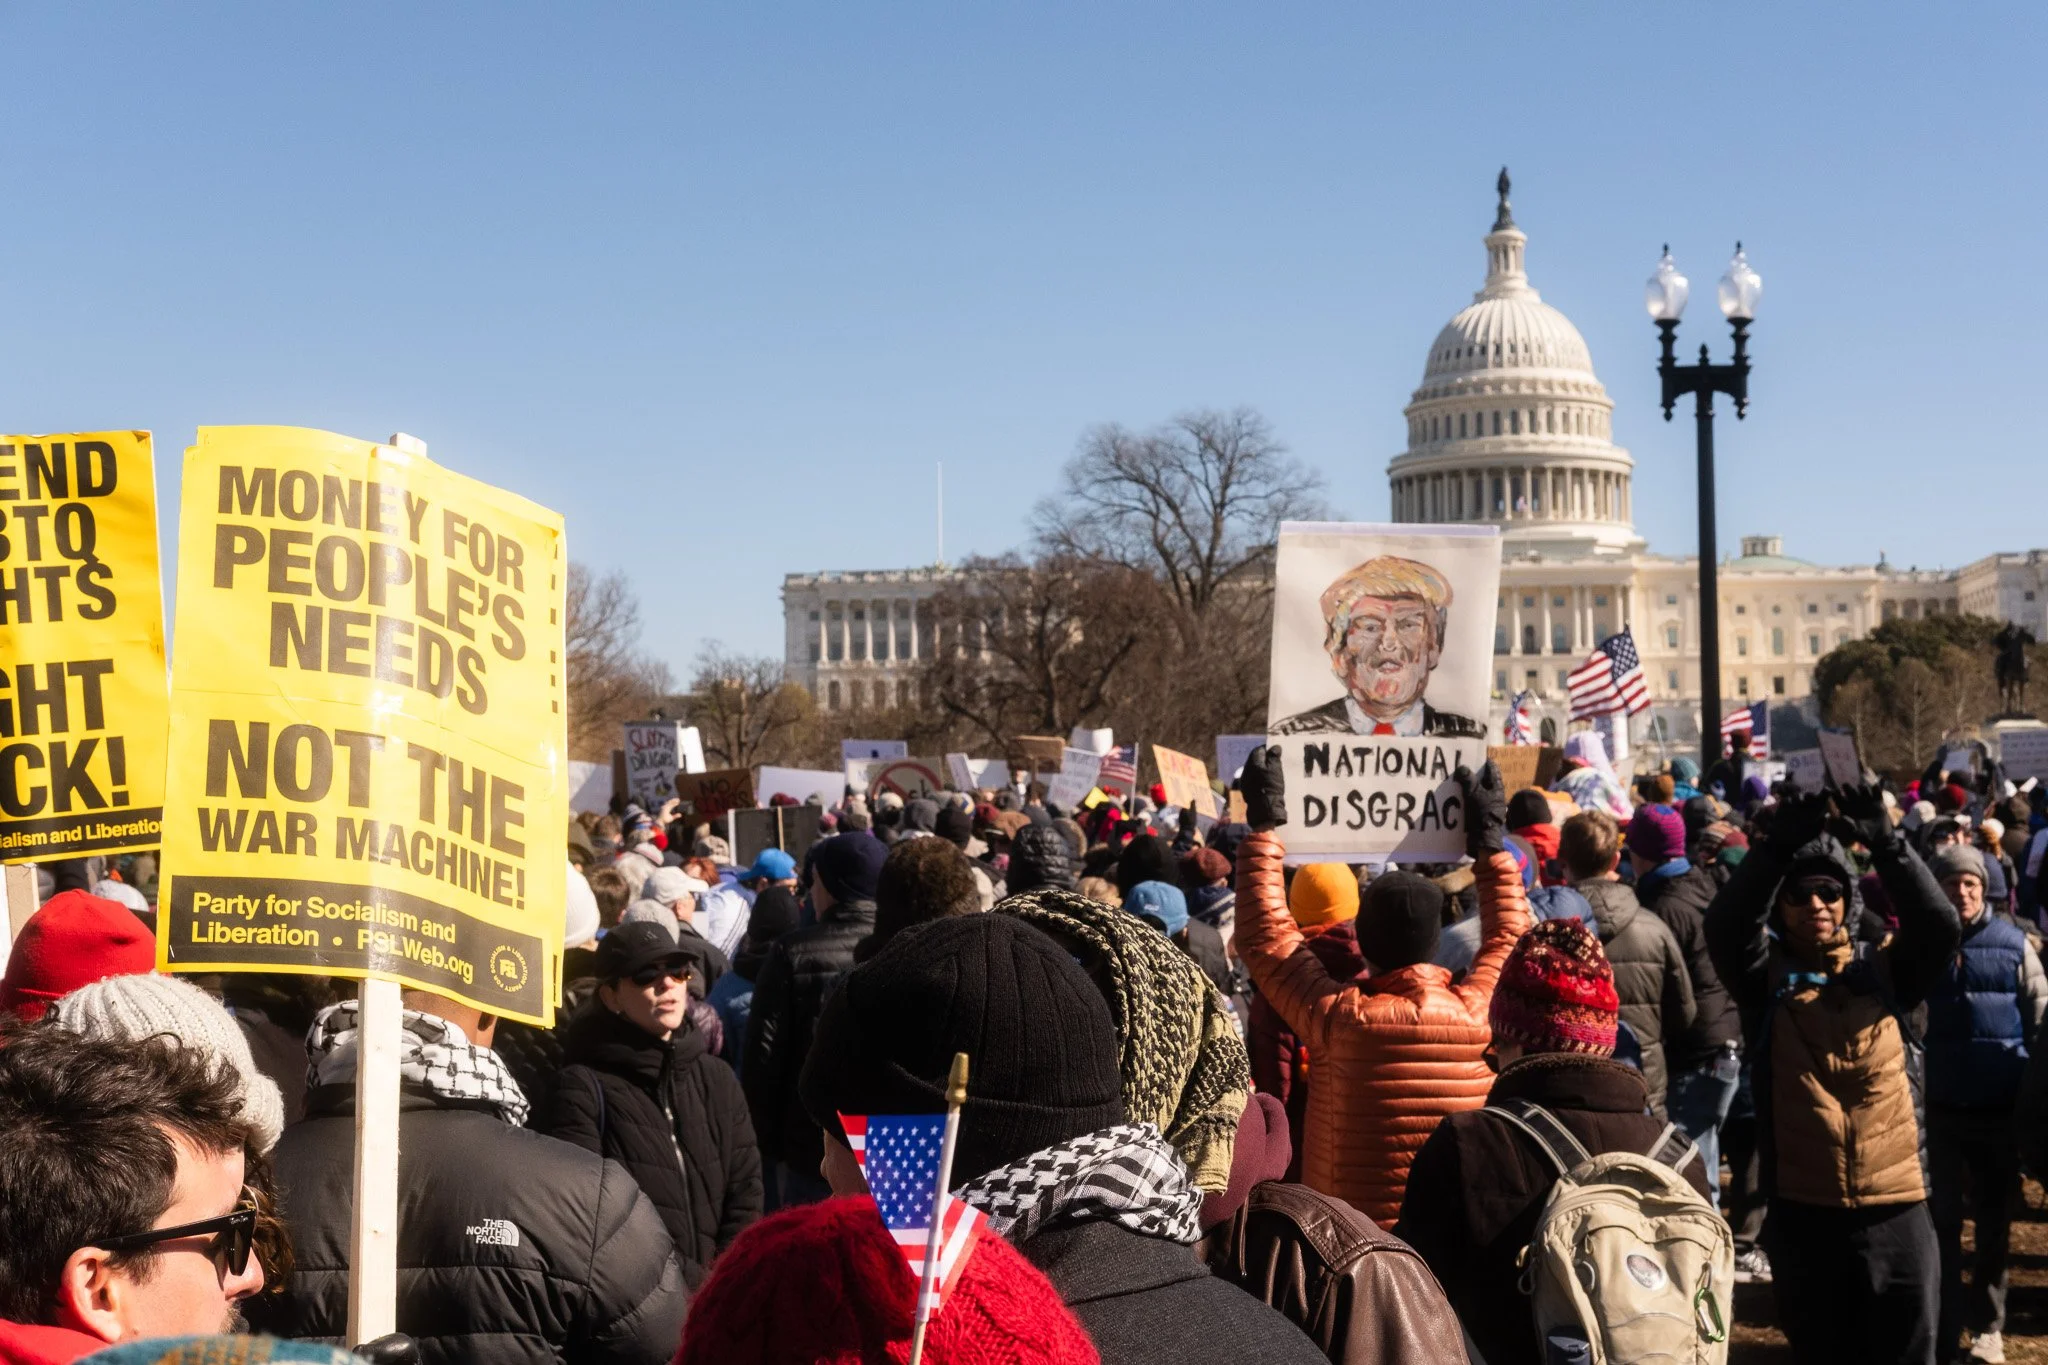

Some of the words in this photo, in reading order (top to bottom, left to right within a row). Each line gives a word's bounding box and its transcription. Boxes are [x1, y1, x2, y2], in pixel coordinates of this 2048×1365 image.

[0, 441, 118, 500] END
[0, 502, 100, 564] TQ
[217, 465, 429, 544] MONEY
[443, 508, 525, 593] FOR
[213, 523, 527, 661] PEOPLE'S
[269, 601, 488, 715] NEEDS
[0, 735, 131, 818] CK!
[205, 719, 386, 809] NOT
[407, 741, 526, 859] THE
[50, 825, 83, 844] and
[86, 818, 163, 840] Liberatio
[197, 807, 318, 857] WAR
[335, 816, 526, 911] MACHINE!
[193, 892, 260, 921] Party
[265, 894, 302, 916] for
[306, 896, 418, 933] Socialism
[421, 919, 457, 944] and
[191, 921, 320, 947] Liberation
[357, 928, 474, 984] PSLWeb.org
[500, 959, 518, 979] PSL
[466, 1226, 502, 1235] NORTH
[475, 1235, 502, 1245] FACE
[483, 1219, 503, 1228] THE
